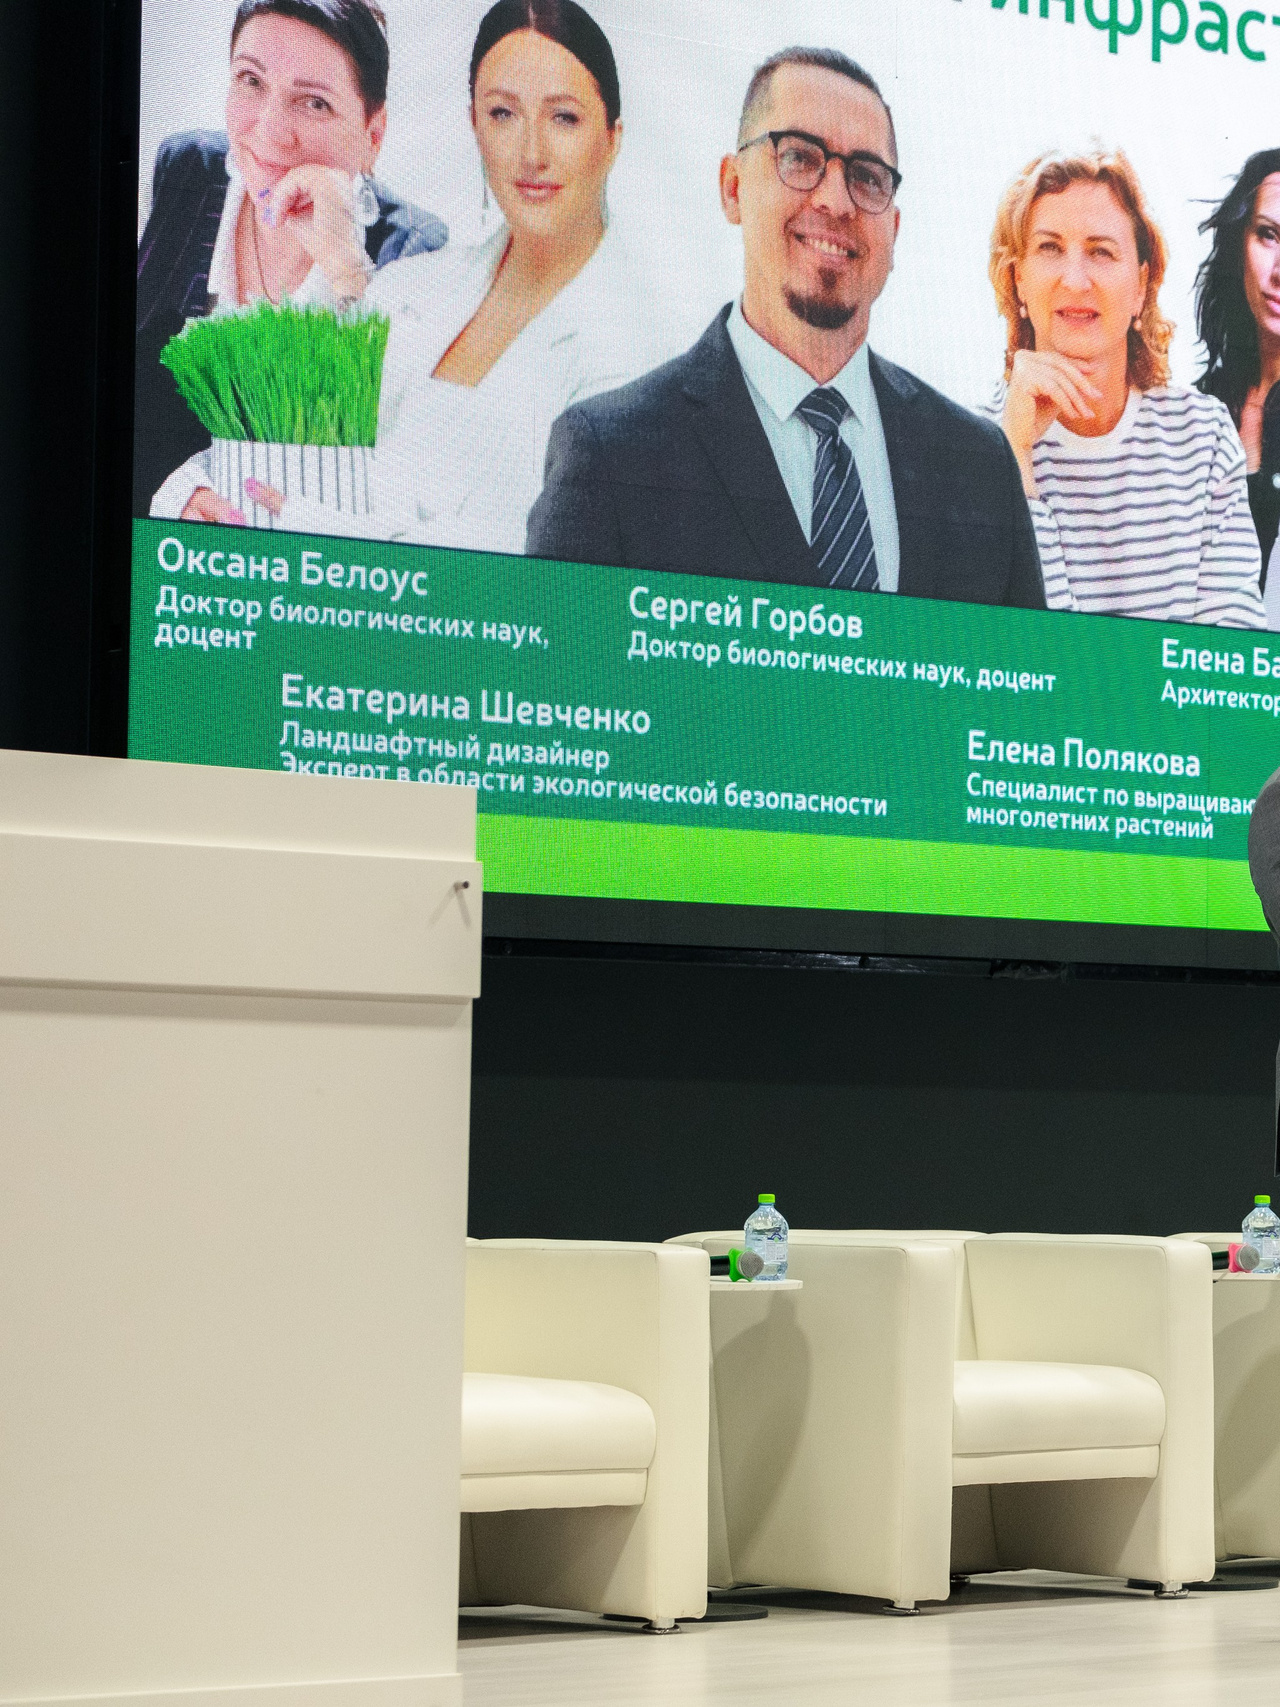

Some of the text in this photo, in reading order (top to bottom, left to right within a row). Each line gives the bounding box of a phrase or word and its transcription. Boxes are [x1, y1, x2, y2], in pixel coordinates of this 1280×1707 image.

[157, 536, 428, 602] Оксана Белоус
[154, 622, 257, 652] доцент
[155, 585, 549, 649] Доктор биологических наук,
[629, 585, 863, 641] Сергей Горбов
[627, 630, 1056, 693] Доктор биологических наук, доцент
[1162, 638, 1245, 675] Елена
[282, 672, 651, 734] Екатерина Шевченко
[279, 720, 610, 774] Ландшафтный дизайнер
[968, 729, 1200, 777] Елена Полякова
[279, 750, 887, 816] Эксперт в области экологической безопасности
[966, 772, 1098, 805] Специалист
[1103, 788, 1129, 806] по
[966, 805, 1216, 839] многолетних растений
